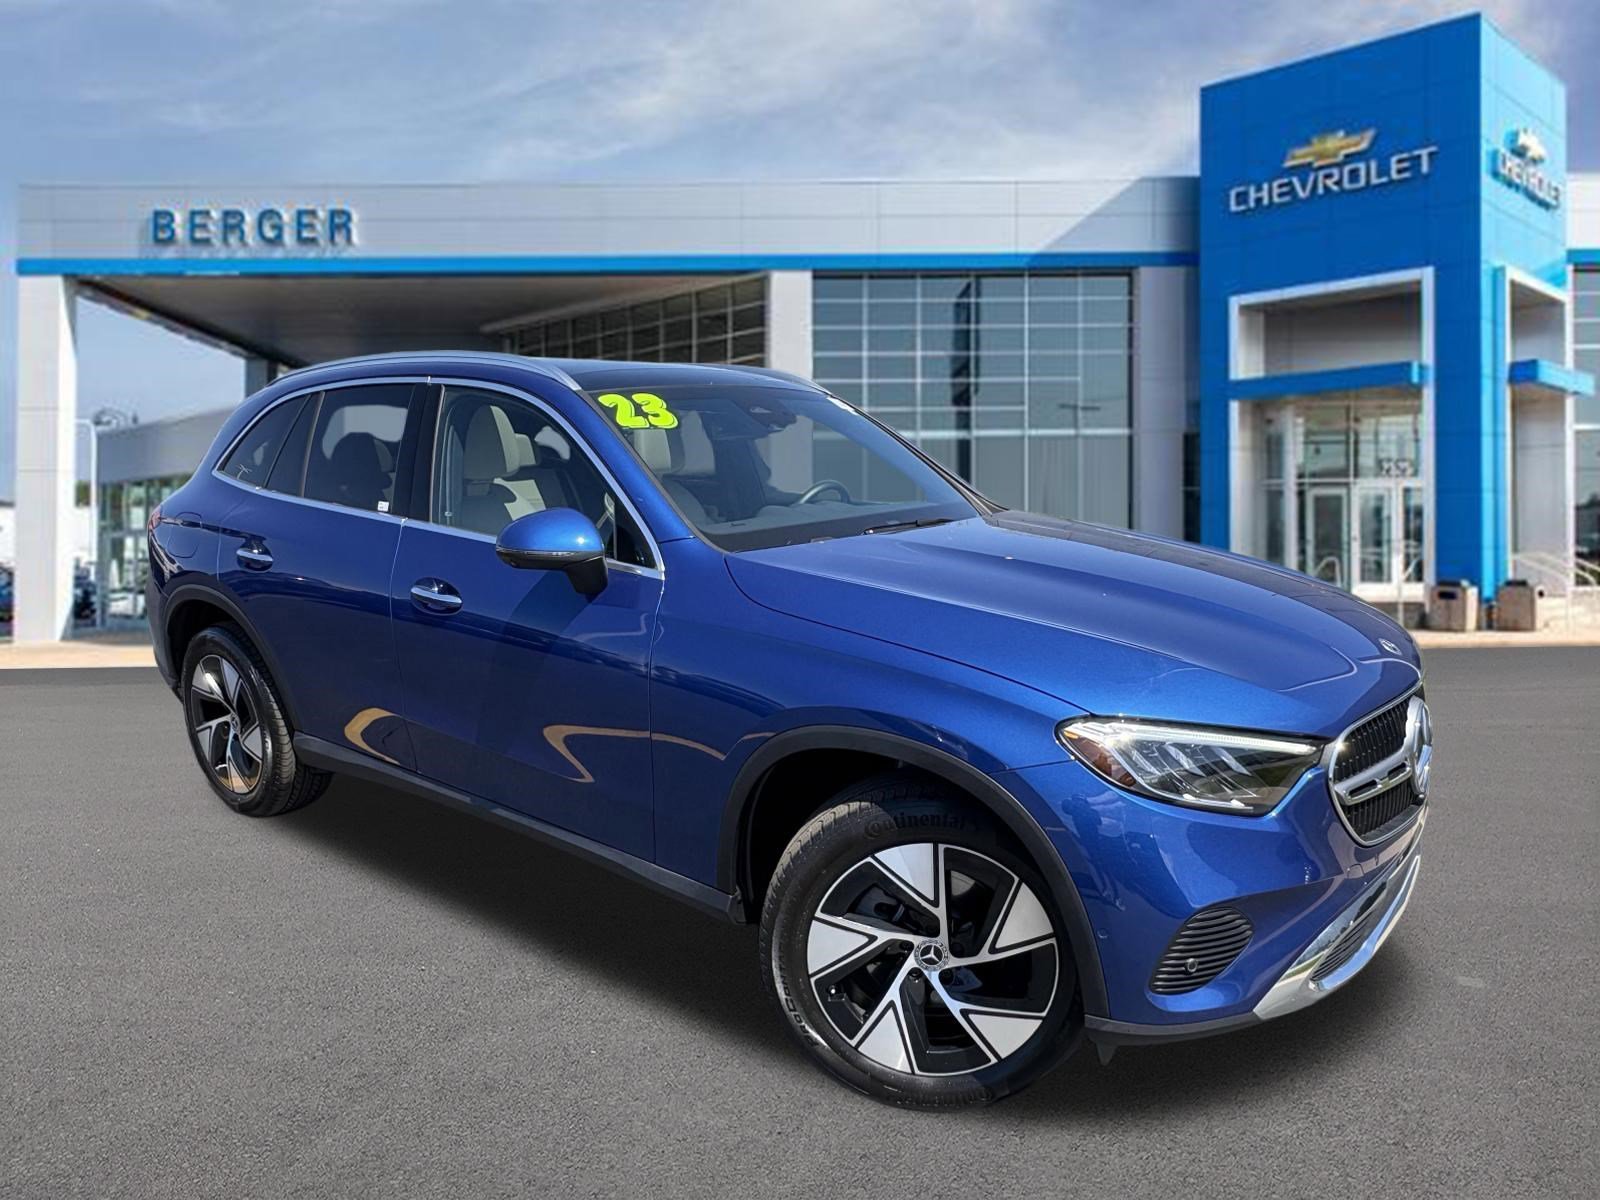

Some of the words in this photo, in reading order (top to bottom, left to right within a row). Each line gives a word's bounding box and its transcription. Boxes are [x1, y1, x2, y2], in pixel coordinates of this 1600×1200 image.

[1229, 146, 1438, 213] CHEVROLET
[152, 208, 356, 246] BERGER
[598, 392, 678, 429] 23
[864, 812, 966, 839] Continental
